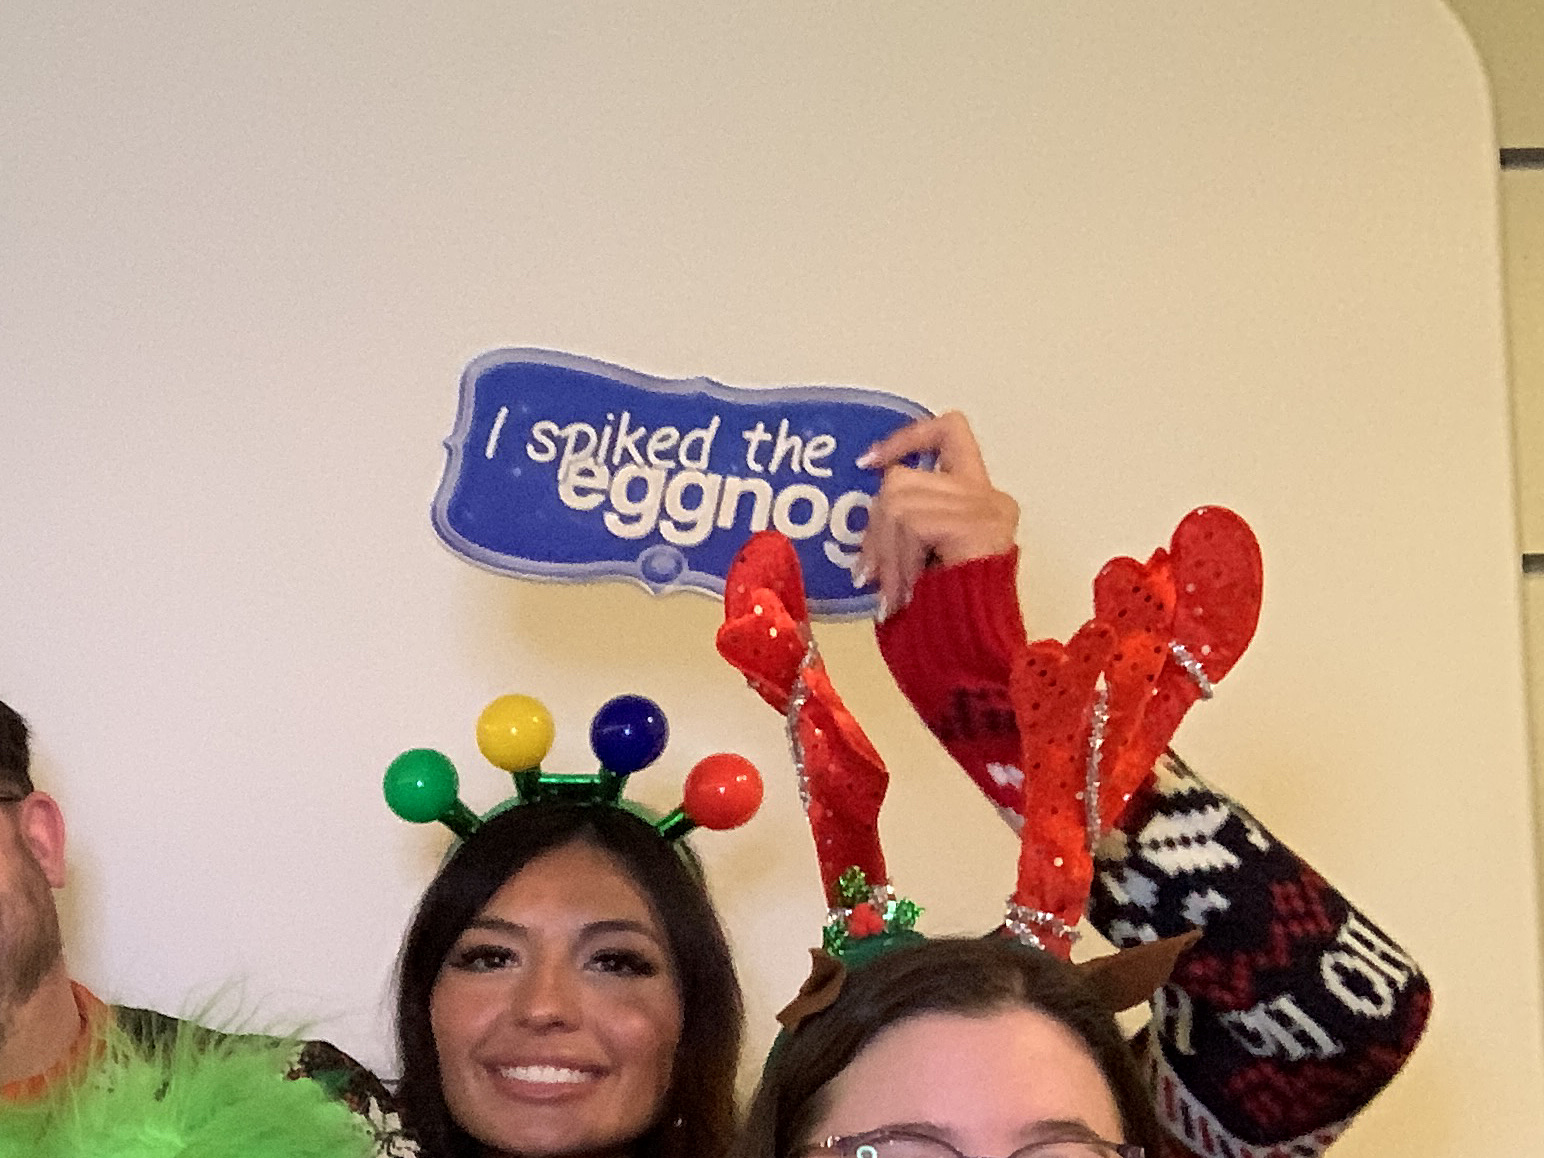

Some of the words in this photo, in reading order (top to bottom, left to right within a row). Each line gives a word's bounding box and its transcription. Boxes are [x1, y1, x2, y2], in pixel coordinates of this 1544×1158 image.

[485, 406, 509, 459] I
[527, 411, 720, 483] spiked
[742, 418, 836, 477] the
[558, 462, 873, 571] eggnog
